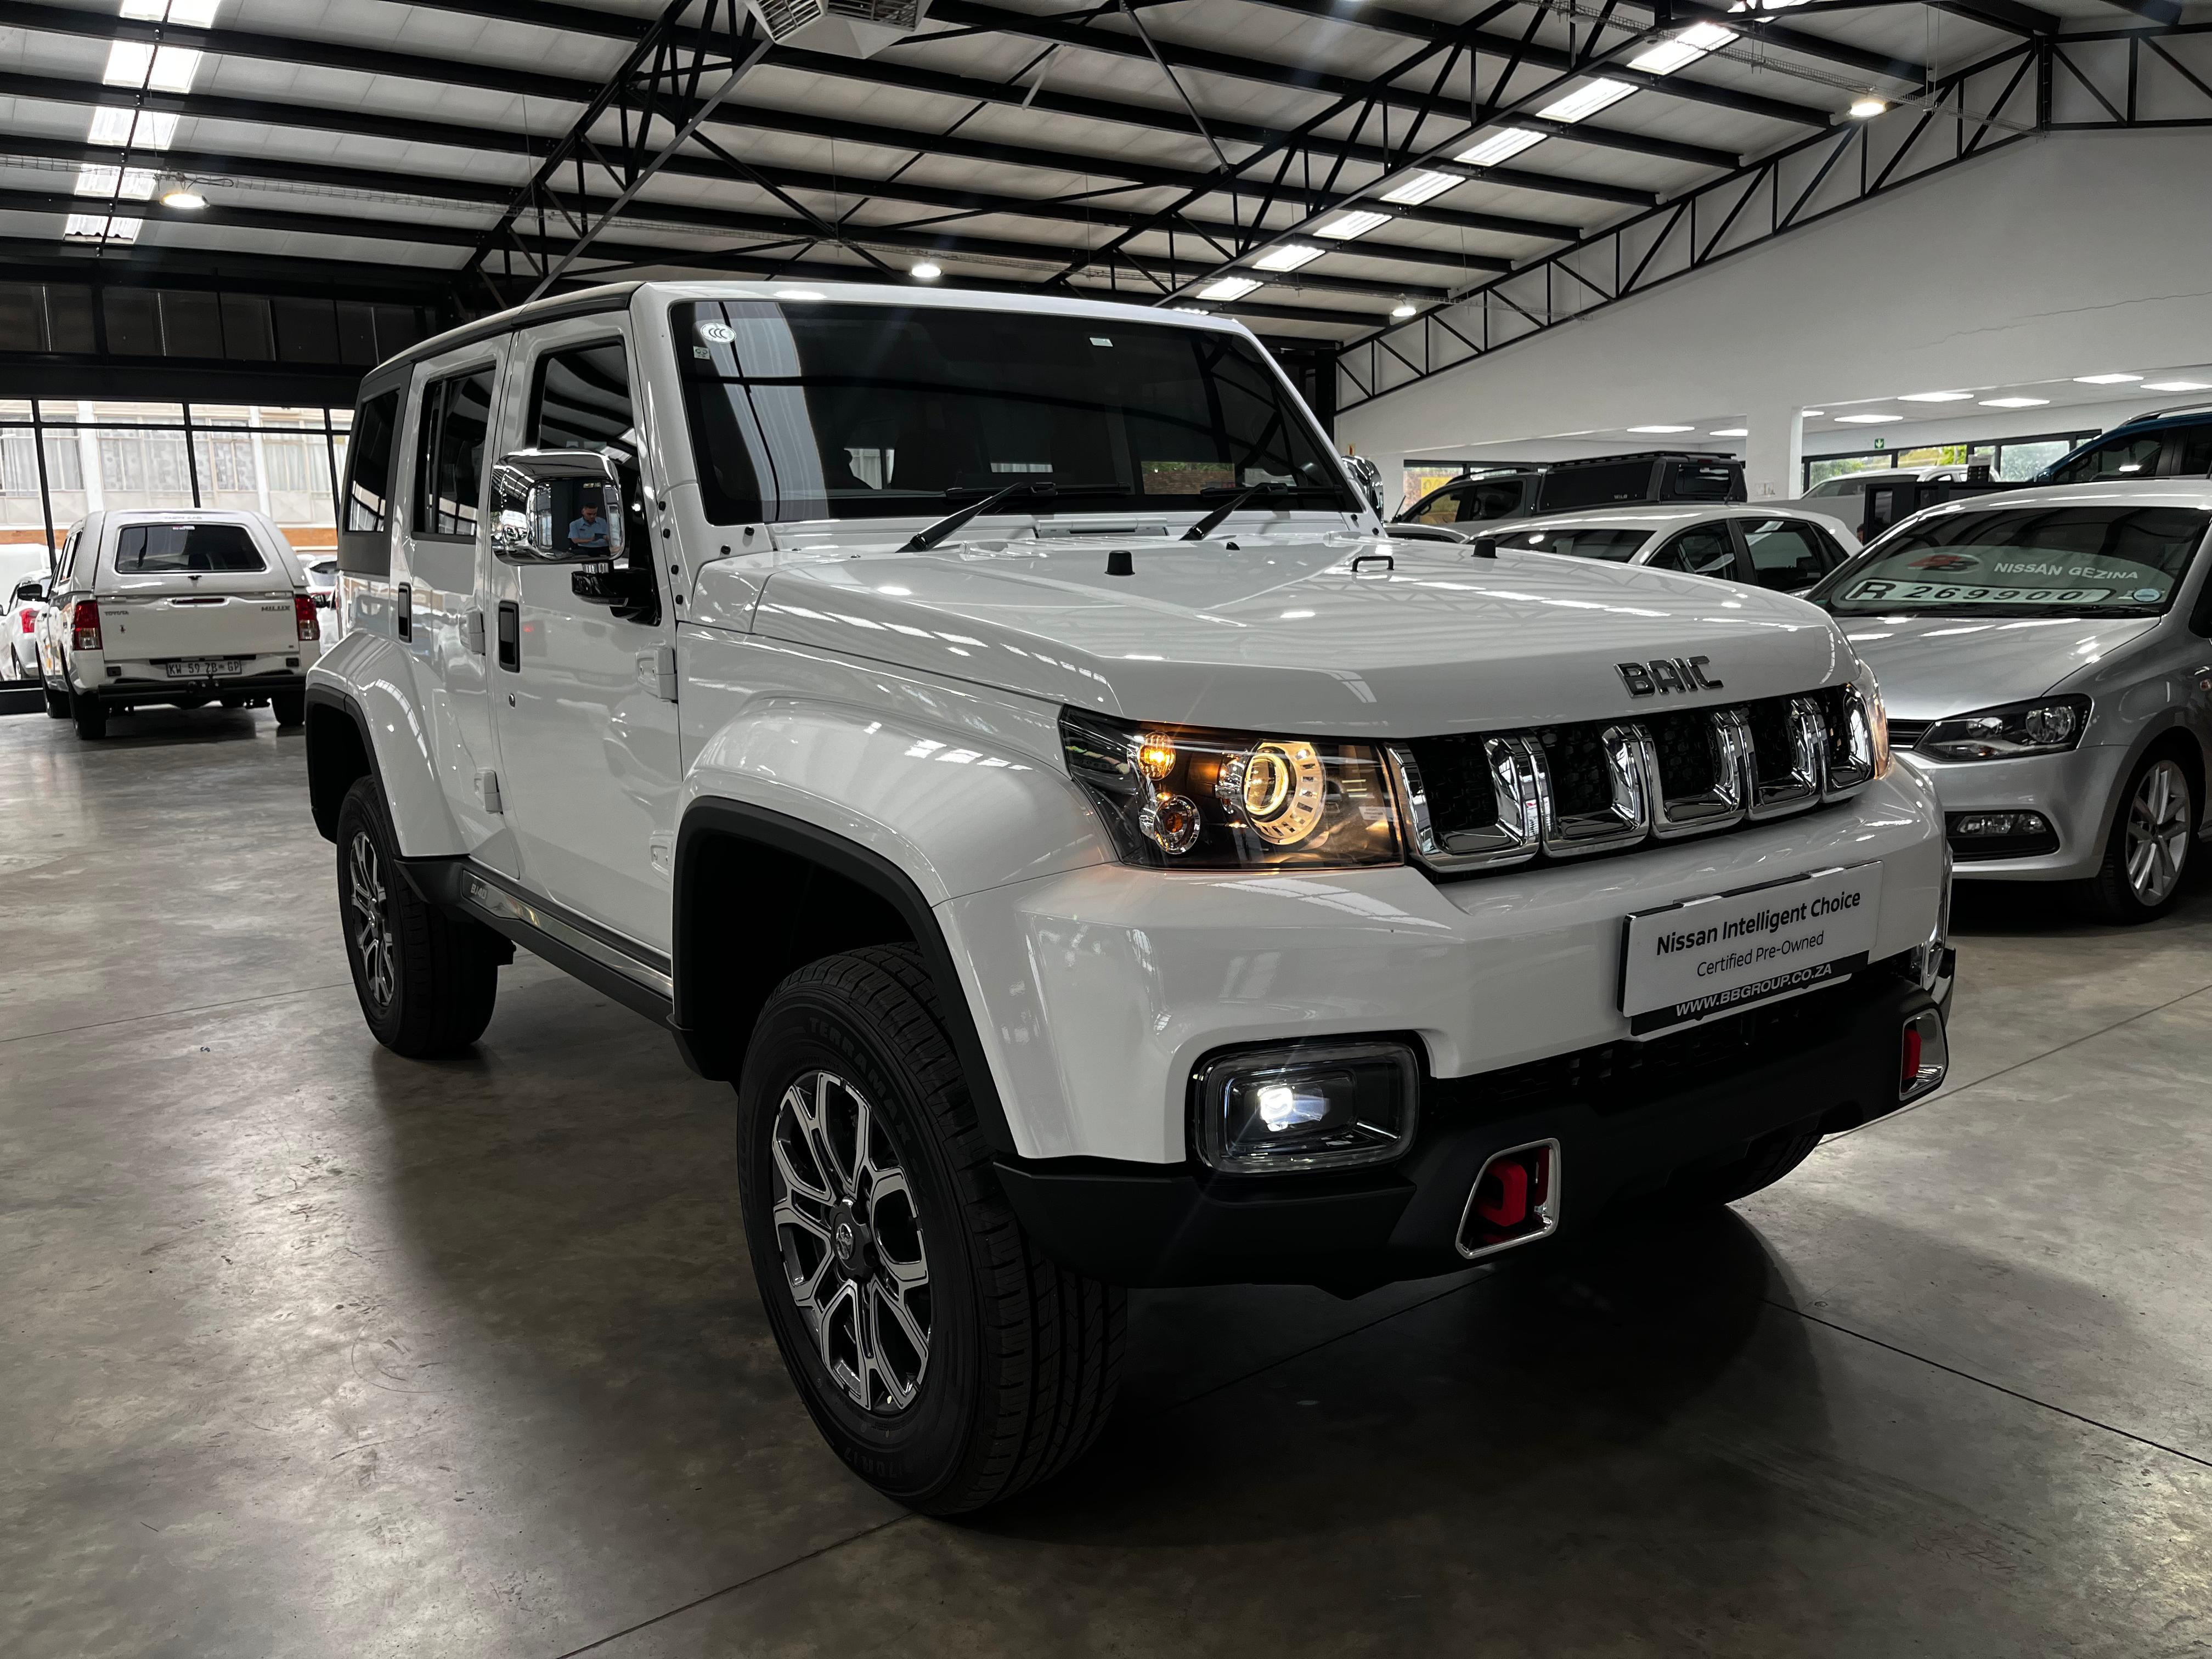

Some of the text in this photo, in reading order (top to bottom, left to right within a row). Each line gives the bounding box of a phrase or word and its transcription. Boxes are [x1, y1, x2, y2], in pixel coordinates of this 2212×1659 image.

[1848, 582, 1896, 600] R
[1994, 562, 2139, 580] NISSAN GEZINA
[169, 662, 182, 674] KW
[188, 662, 200, 674] 59
[227, 661, 239, 672] GP
[1613, 655, 1724, 698] BAIC
[1656, 891, 1860, 956] Nissan Intelligent Choice
[1697, 930, 1824, 977] Certified Pre-Owned
[1676, 964, 1832, 1016] WWW.BBGROUP.CO.ZA
[809, 1017, 912, 1146] TERRAMAX
